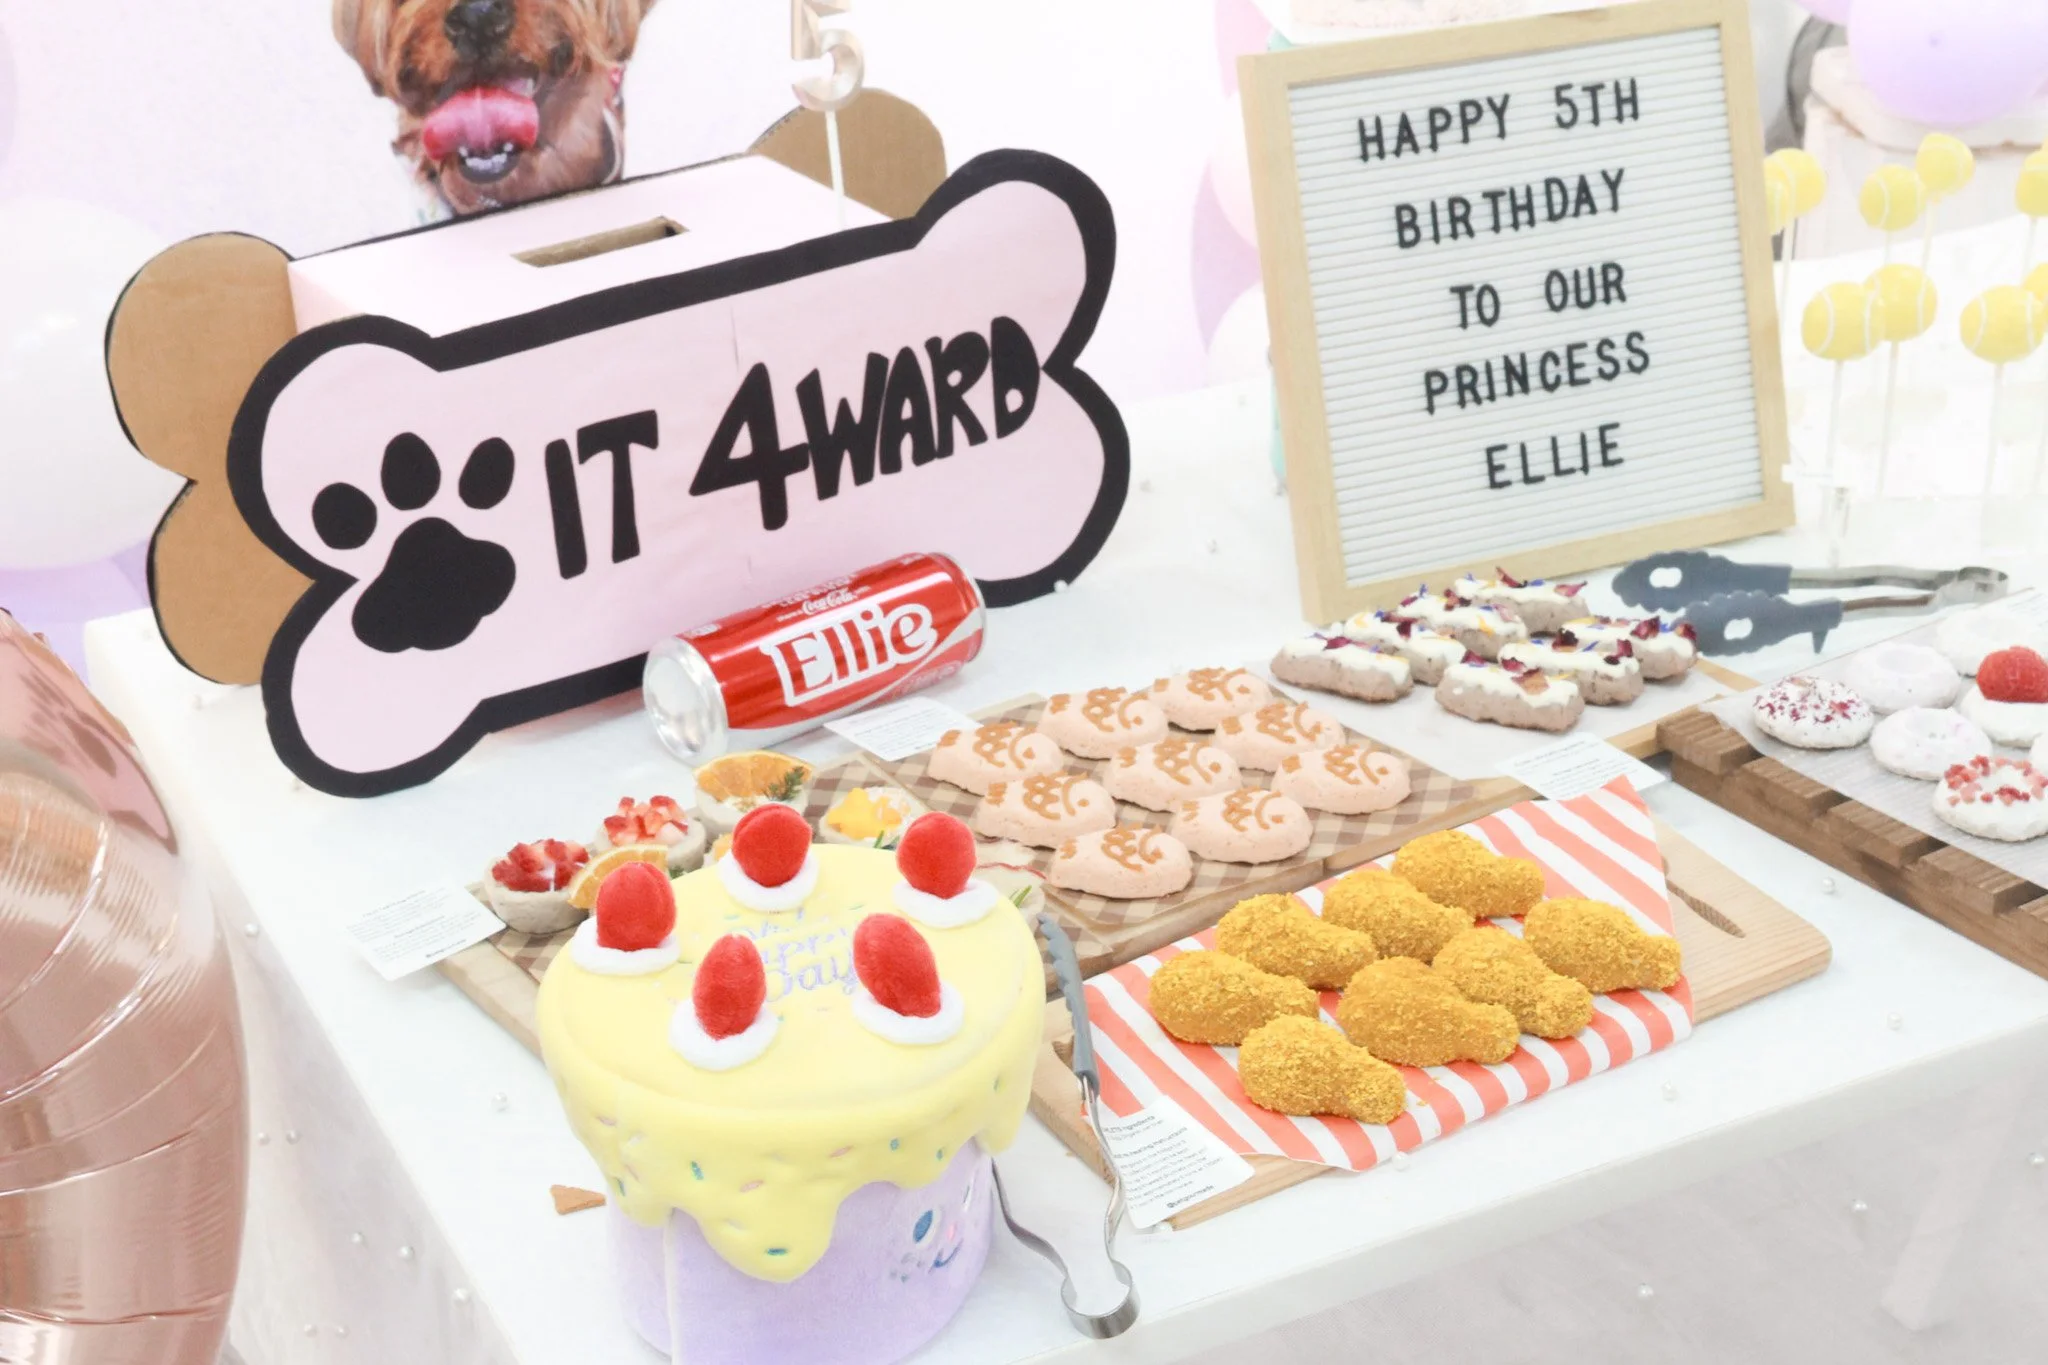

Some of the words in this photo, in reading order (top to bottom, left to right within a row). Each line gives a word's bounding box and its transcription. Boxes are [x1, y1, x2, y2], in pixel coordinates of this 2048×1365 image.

[1357, 94, 1510, 163] HAPPY
[1554, 77, 1639, 129] 5TH
[1394, 168, 1625, 249] BIRTHDAY
[1449, 284, 1501, 330] TO
[1544, 262, 1627, 313] OUR
[1423, 331, 1650, 415] PRINCESS
[544, 409, 659, 580] IT
[688, 315, 1040, 531] 4WARD
[1485, 422, 1624, 490] ELLIE
[765, 605, 930, 704] Ellie
